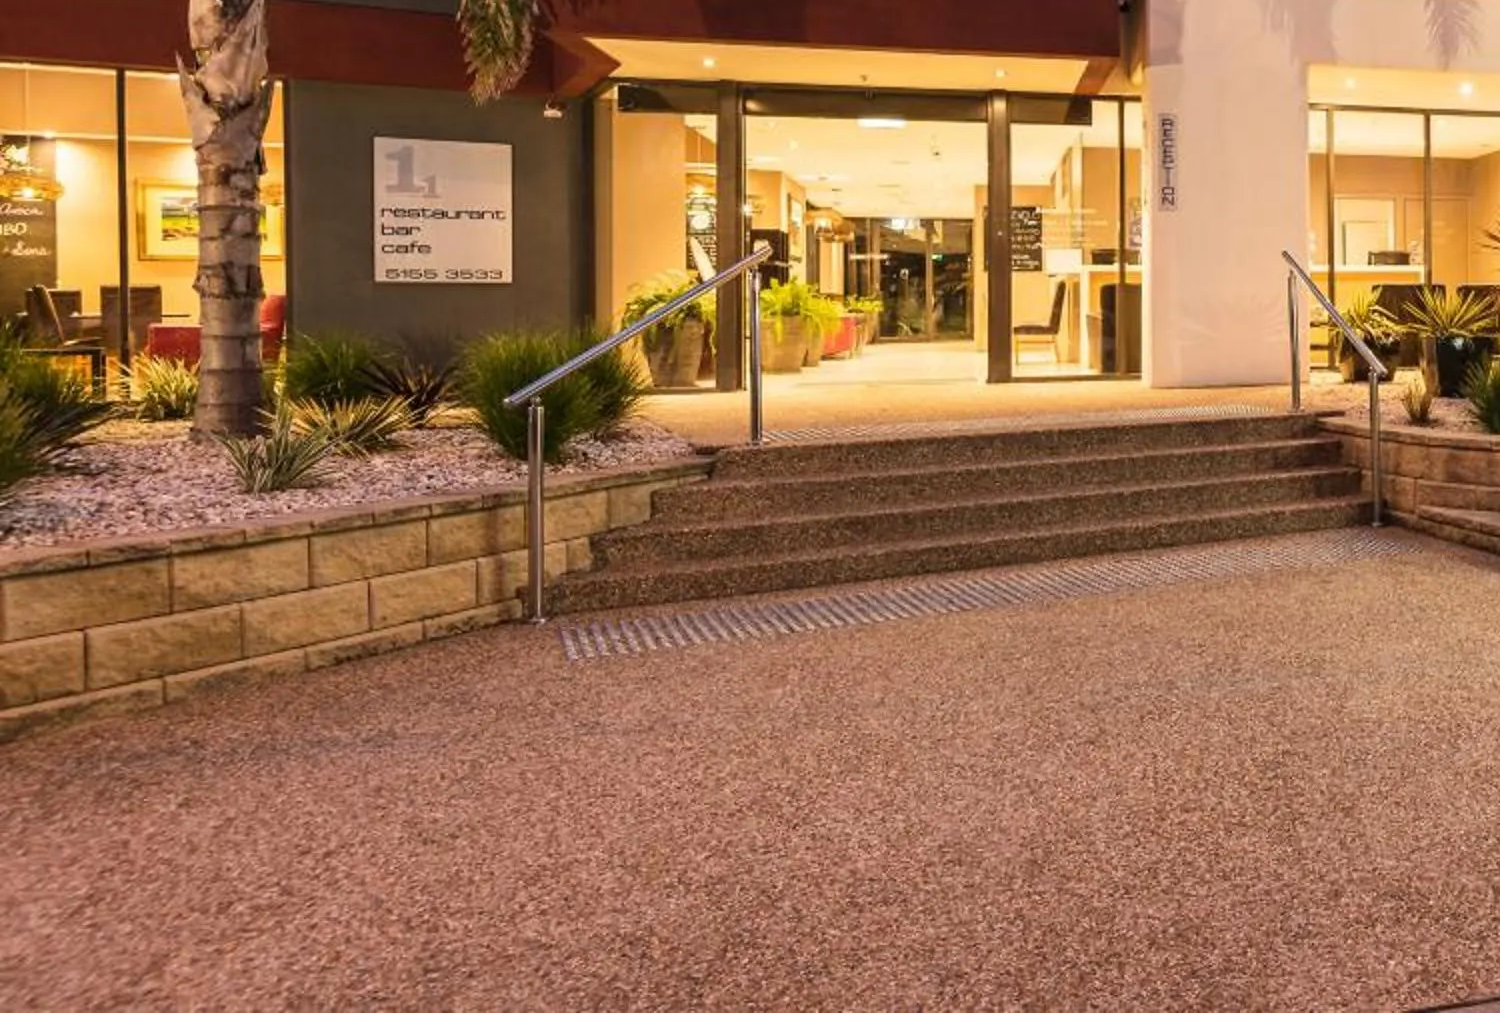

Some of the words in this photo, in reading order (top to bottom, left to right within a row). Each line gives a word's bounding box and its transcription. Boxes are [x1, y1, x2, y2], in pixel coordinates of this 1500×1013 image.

[380, 206, 507, 221] restaurant
[380, 223, 421, 237] bar
[380, 240, 433, 255] cafe
